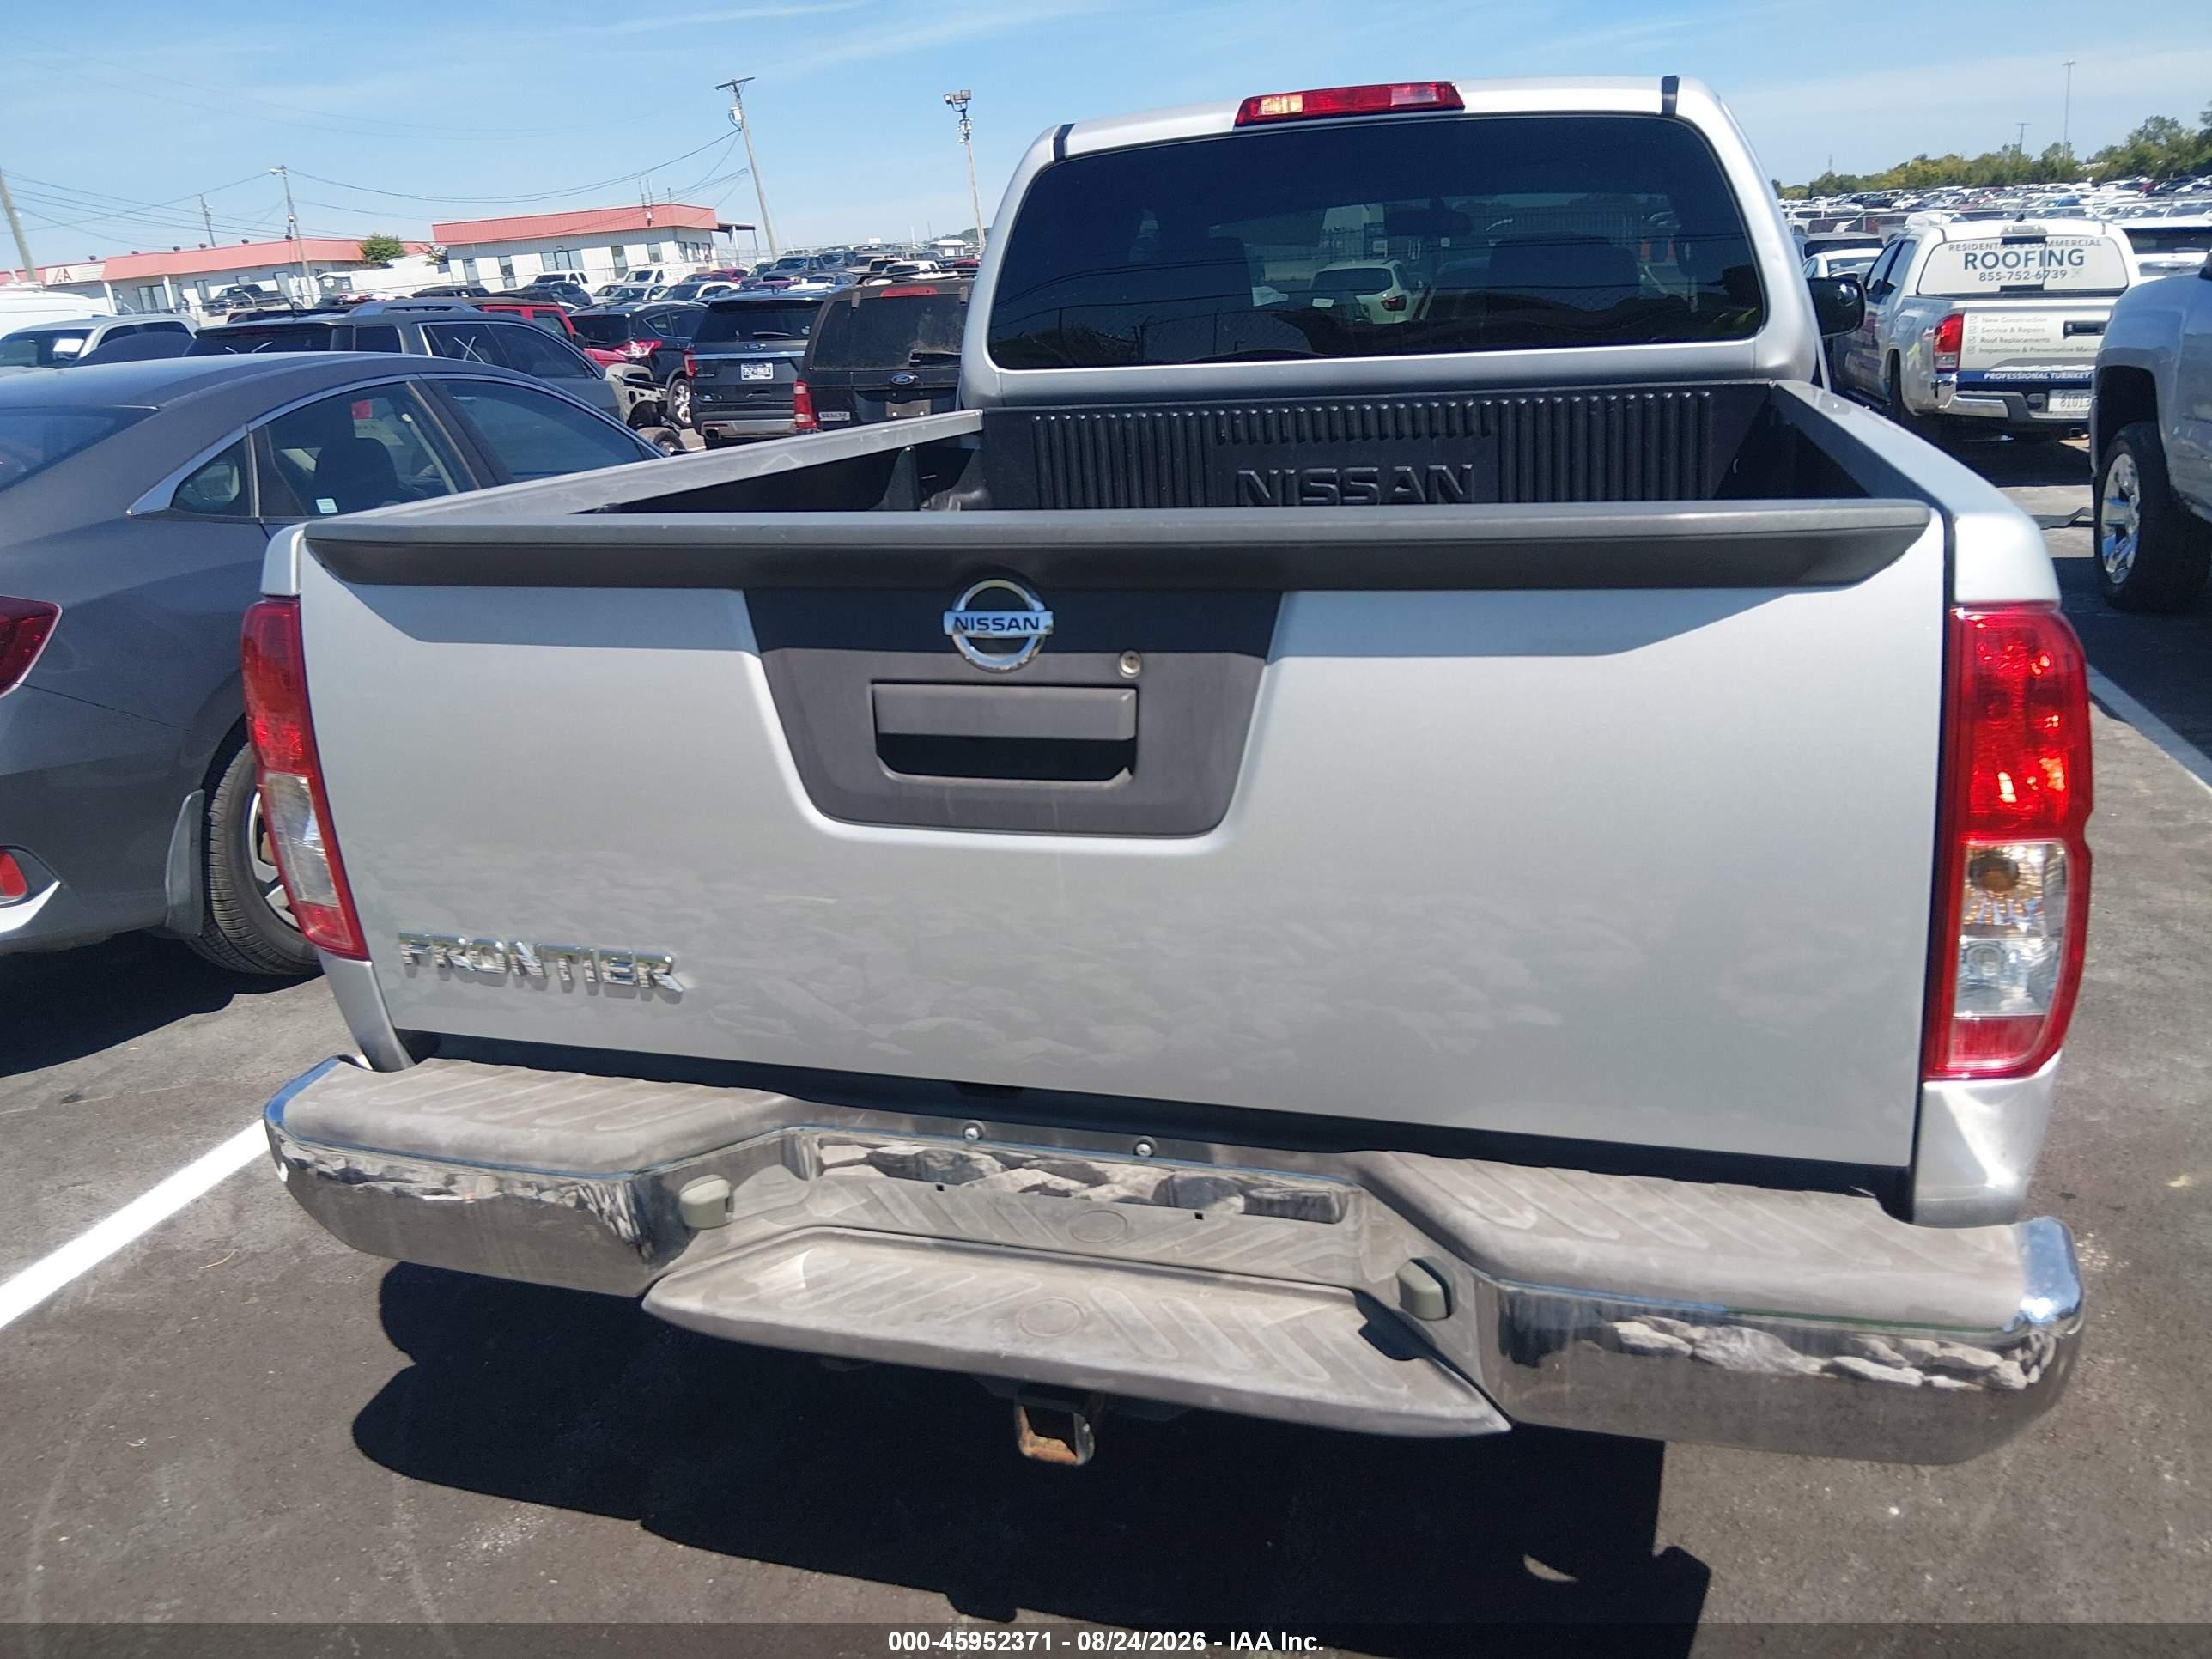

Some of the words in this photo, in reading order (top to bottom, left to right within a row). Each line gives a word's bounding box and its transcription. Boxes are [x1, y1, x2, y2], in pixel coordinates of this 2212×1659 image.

[1964, 248, 2085, 270] ROOFING
[1978, 269, 2068, 282] 855-752-6739
[1236, 464, 1473, 506] NISSAN
[954, 617, 1040, 631] NISSAN
[398, 932, 685, 993] FRONTIER
